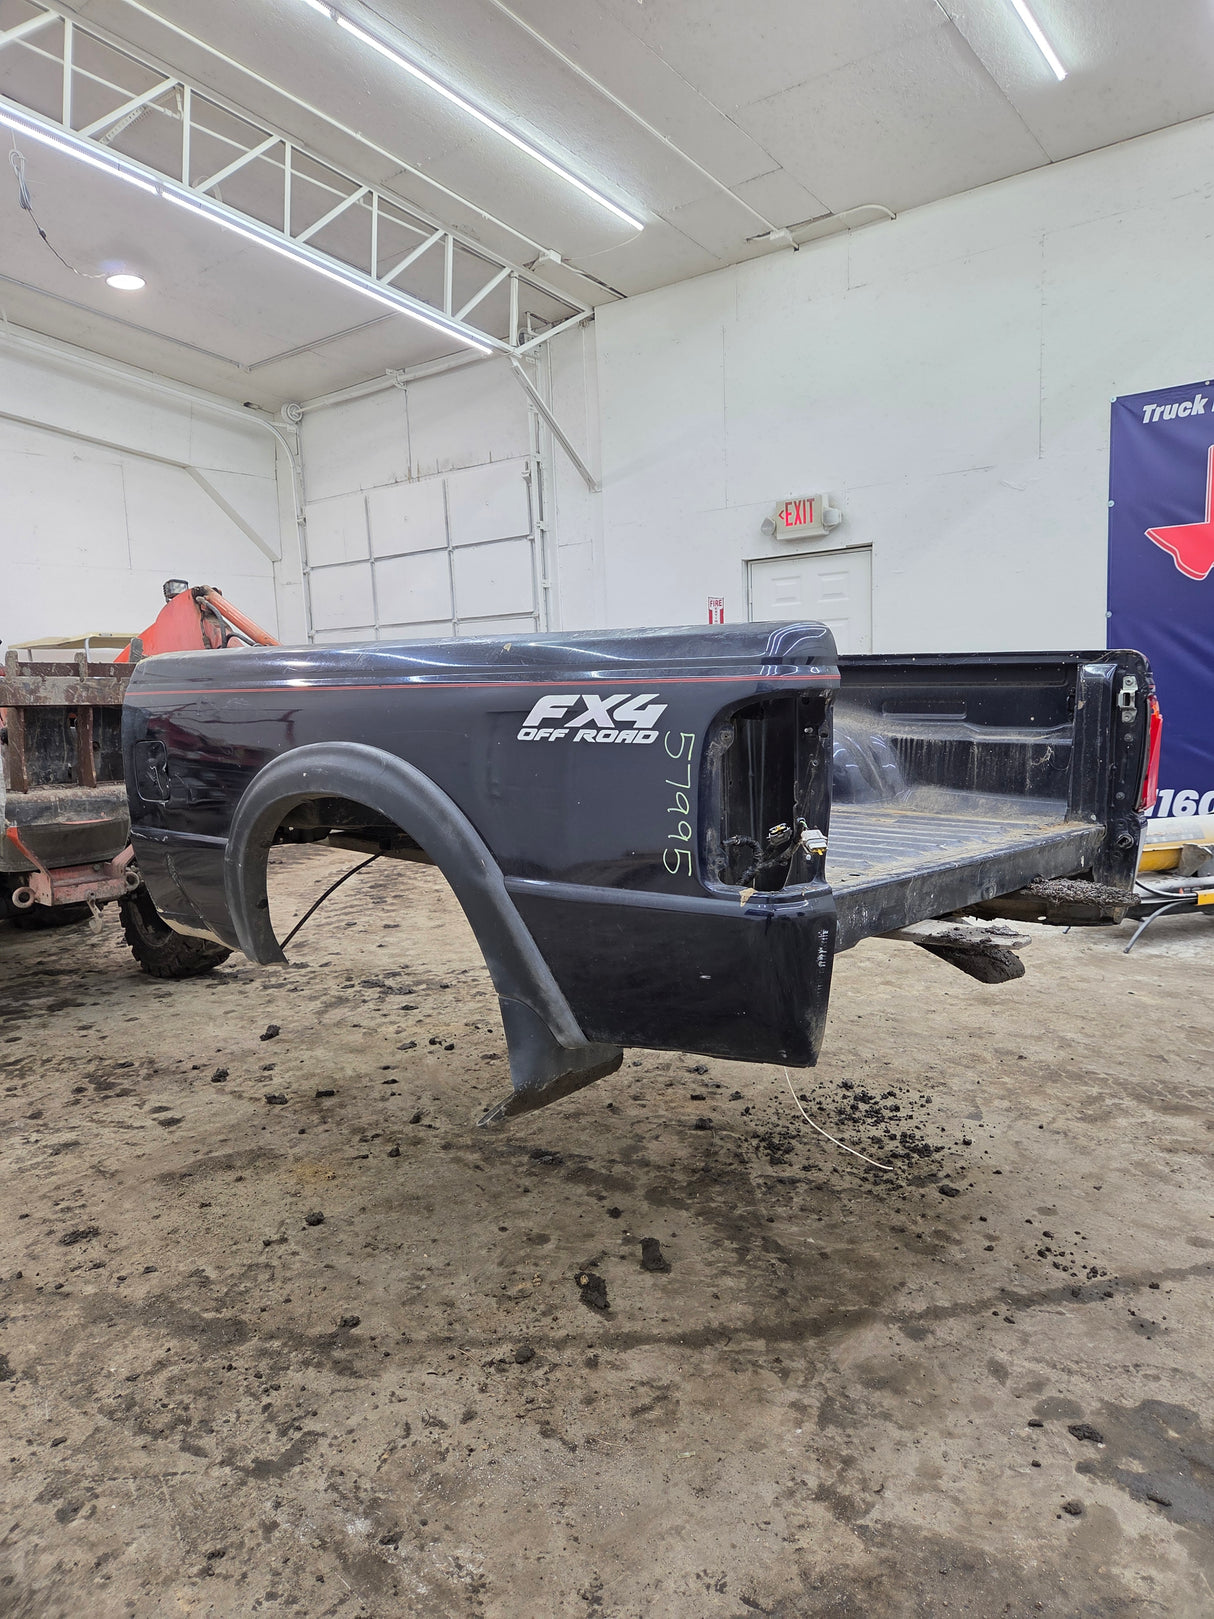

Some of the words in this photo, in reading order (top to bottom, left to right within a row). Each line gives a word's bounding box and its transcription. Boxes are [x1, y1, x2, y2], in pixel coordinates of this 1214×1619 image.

[1142, 394, 1209, 424] Truck
[785, 498, 815, 527] EXIT
[709, 599, 723, 607] FIRE
[522, 693, 668, 728] FX4
[517, 728, 570, 741] OFF
[573, 729, 660, 744] ROAD
[662, 730, 696, 877] 57995
